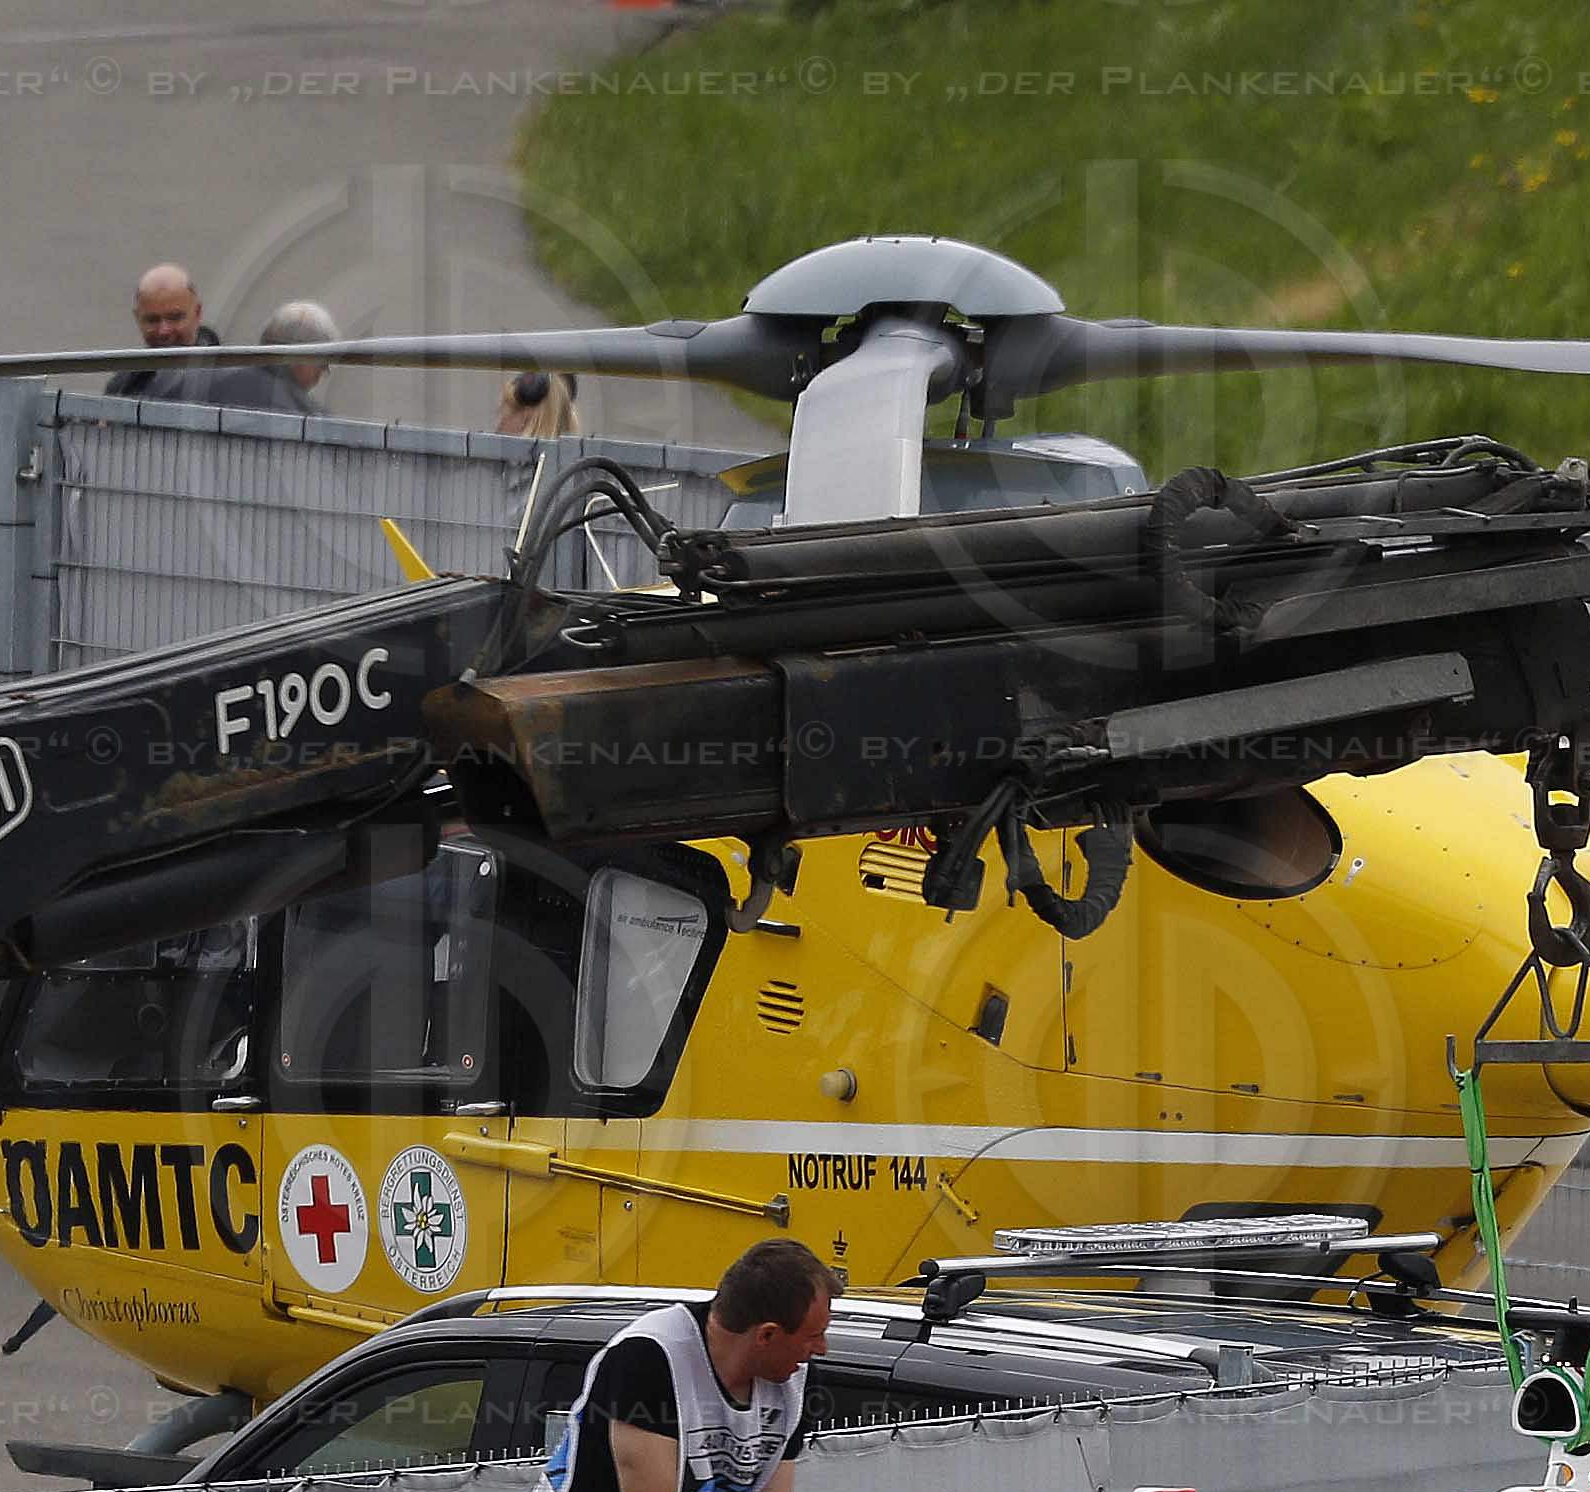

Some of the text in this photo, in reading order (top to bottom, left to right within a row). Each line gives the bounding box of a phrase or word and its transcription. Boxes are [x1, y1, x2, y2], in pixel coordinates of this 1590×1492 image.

[381, 1151, 464, 1219] BERGRETTUNGSDIENST
[789, 1153, 927, 1191] NOTRUF 144
[388, 1245, 460, 1289] ÖSTERREICH
